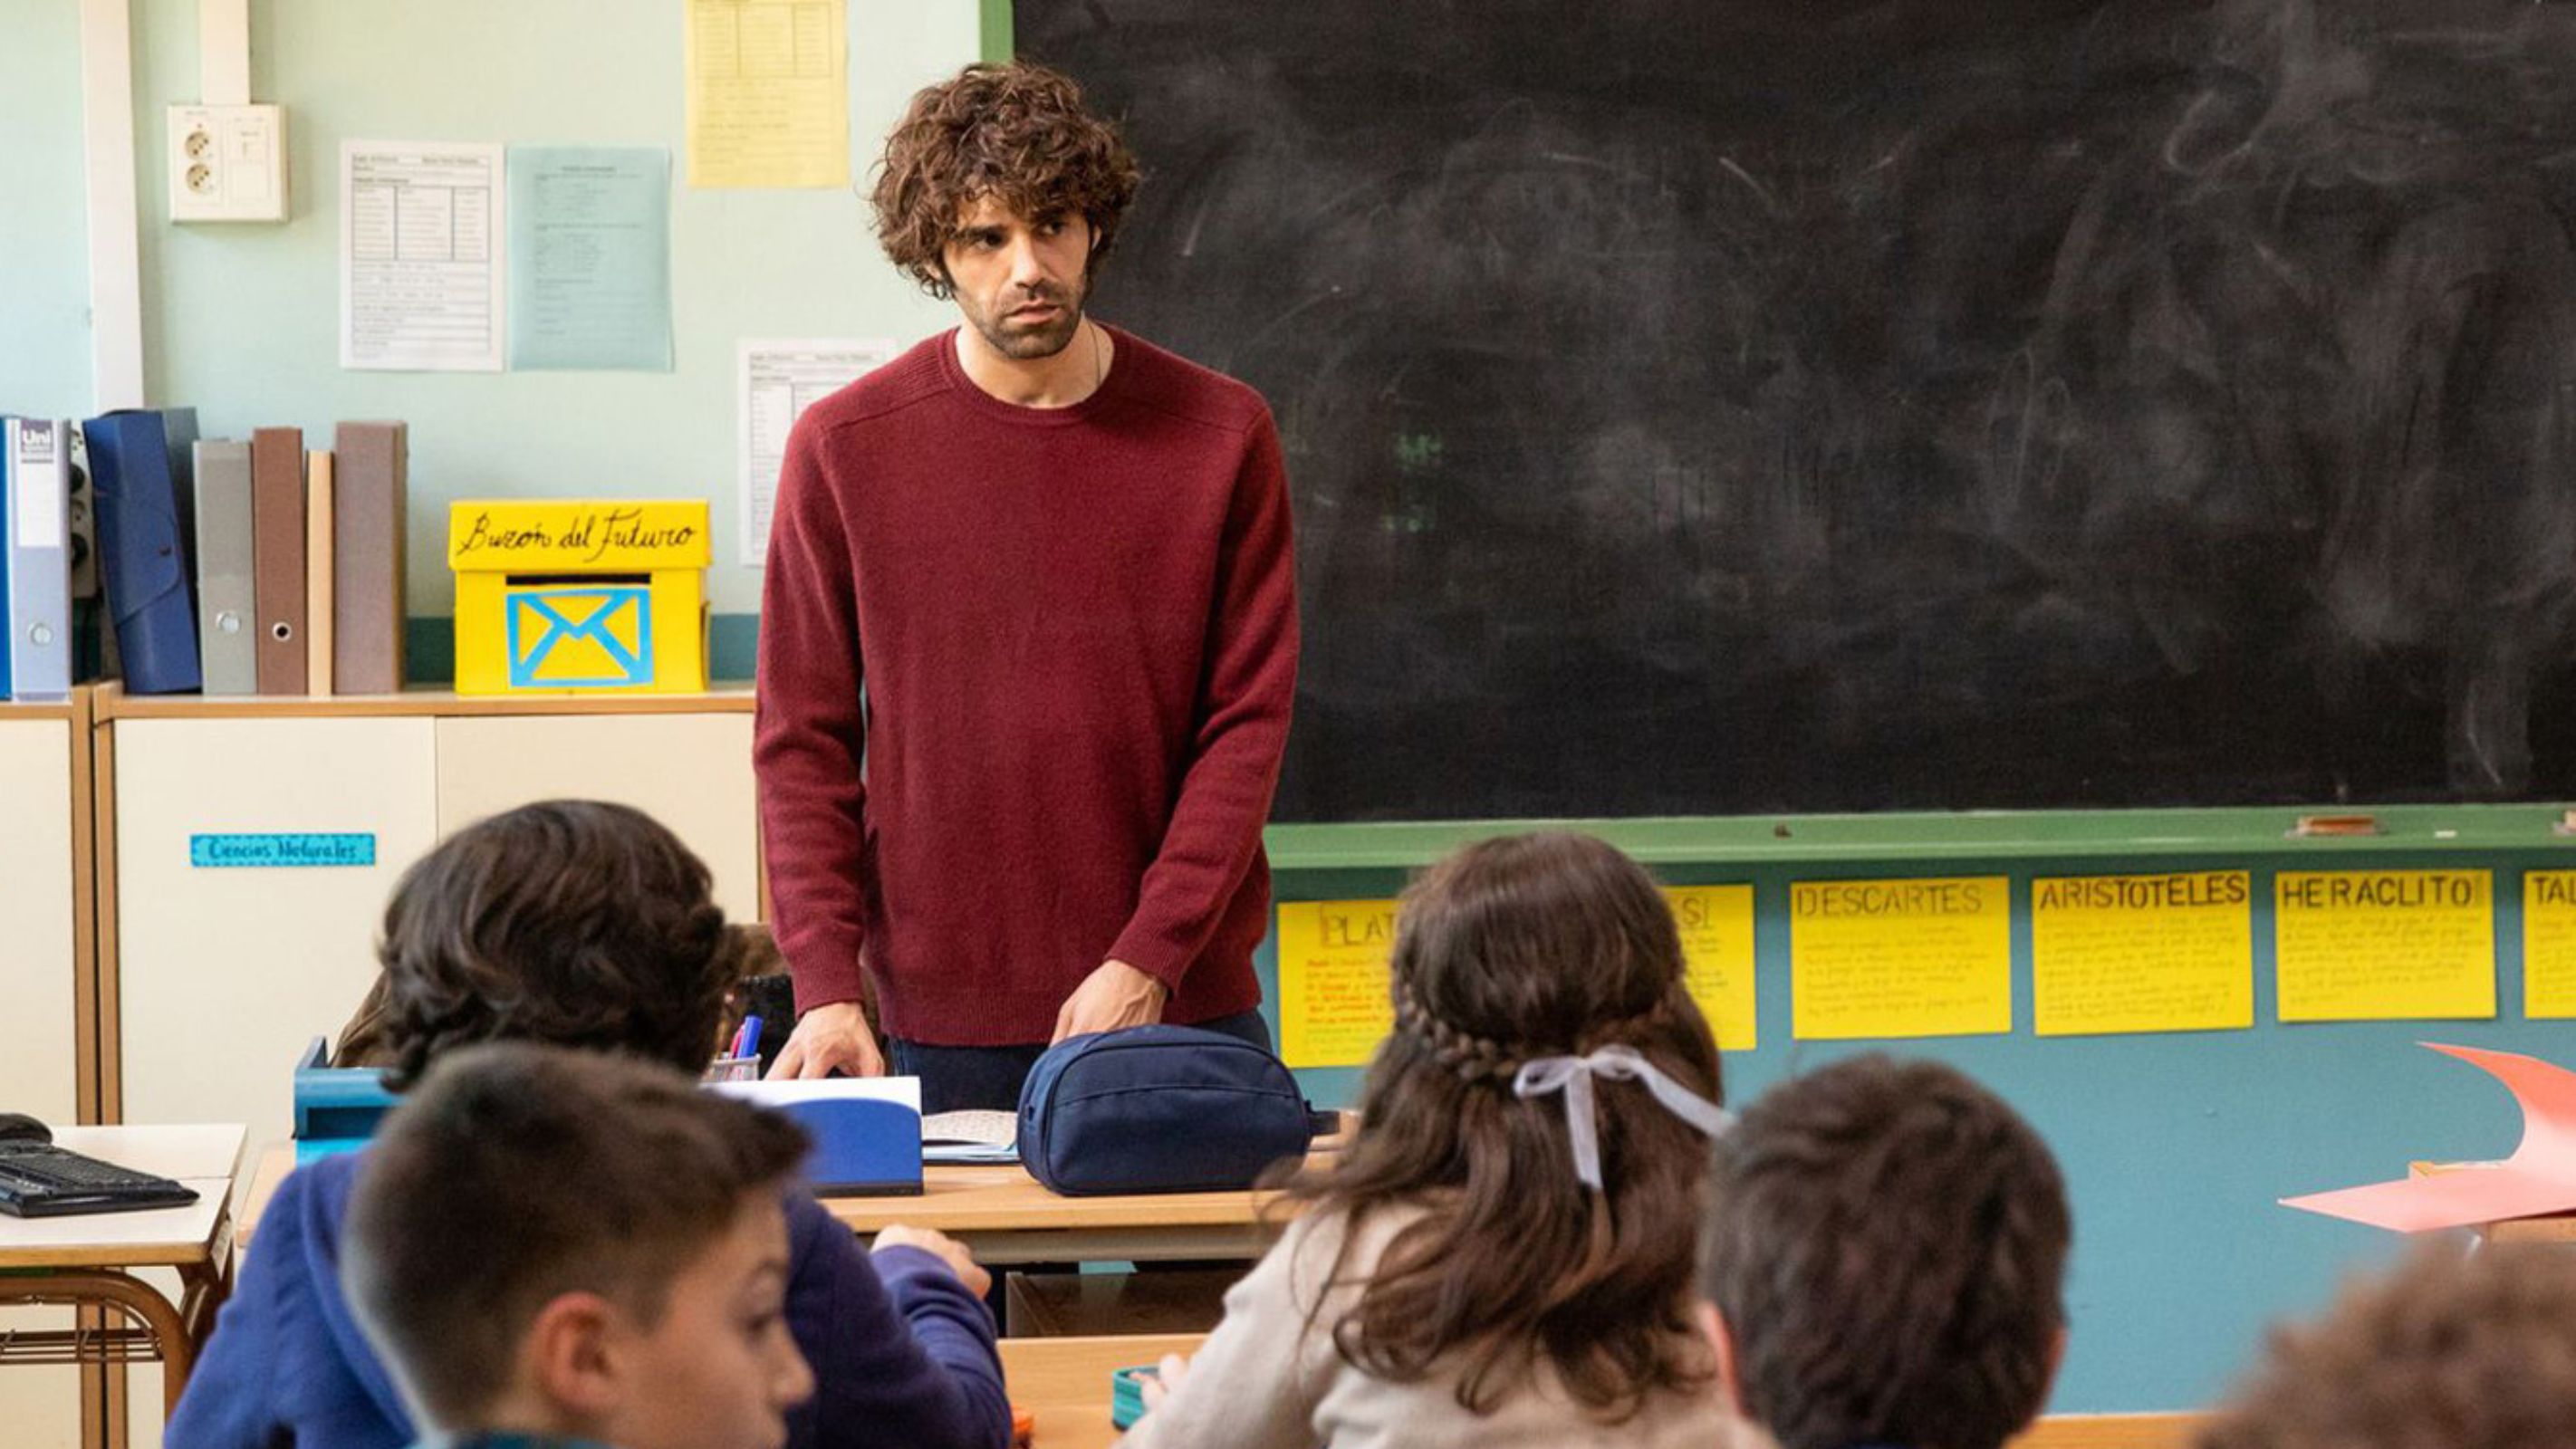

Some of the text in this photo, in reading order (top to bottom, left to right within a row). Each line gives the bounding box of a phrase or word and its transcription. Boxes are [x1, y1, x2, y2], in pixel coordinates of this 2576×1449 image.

[23, 429, 52, 445] Uni
[456, 507, 697, 564] Buzón del Futuro
[277, 839, 357, 859] Naturales
[1796, 883, 1983, 917] DESCARTES
[2039, 873, 2247, 911] ARISTOTELES
[2283, 875, 2473, 909] HERACLITO
